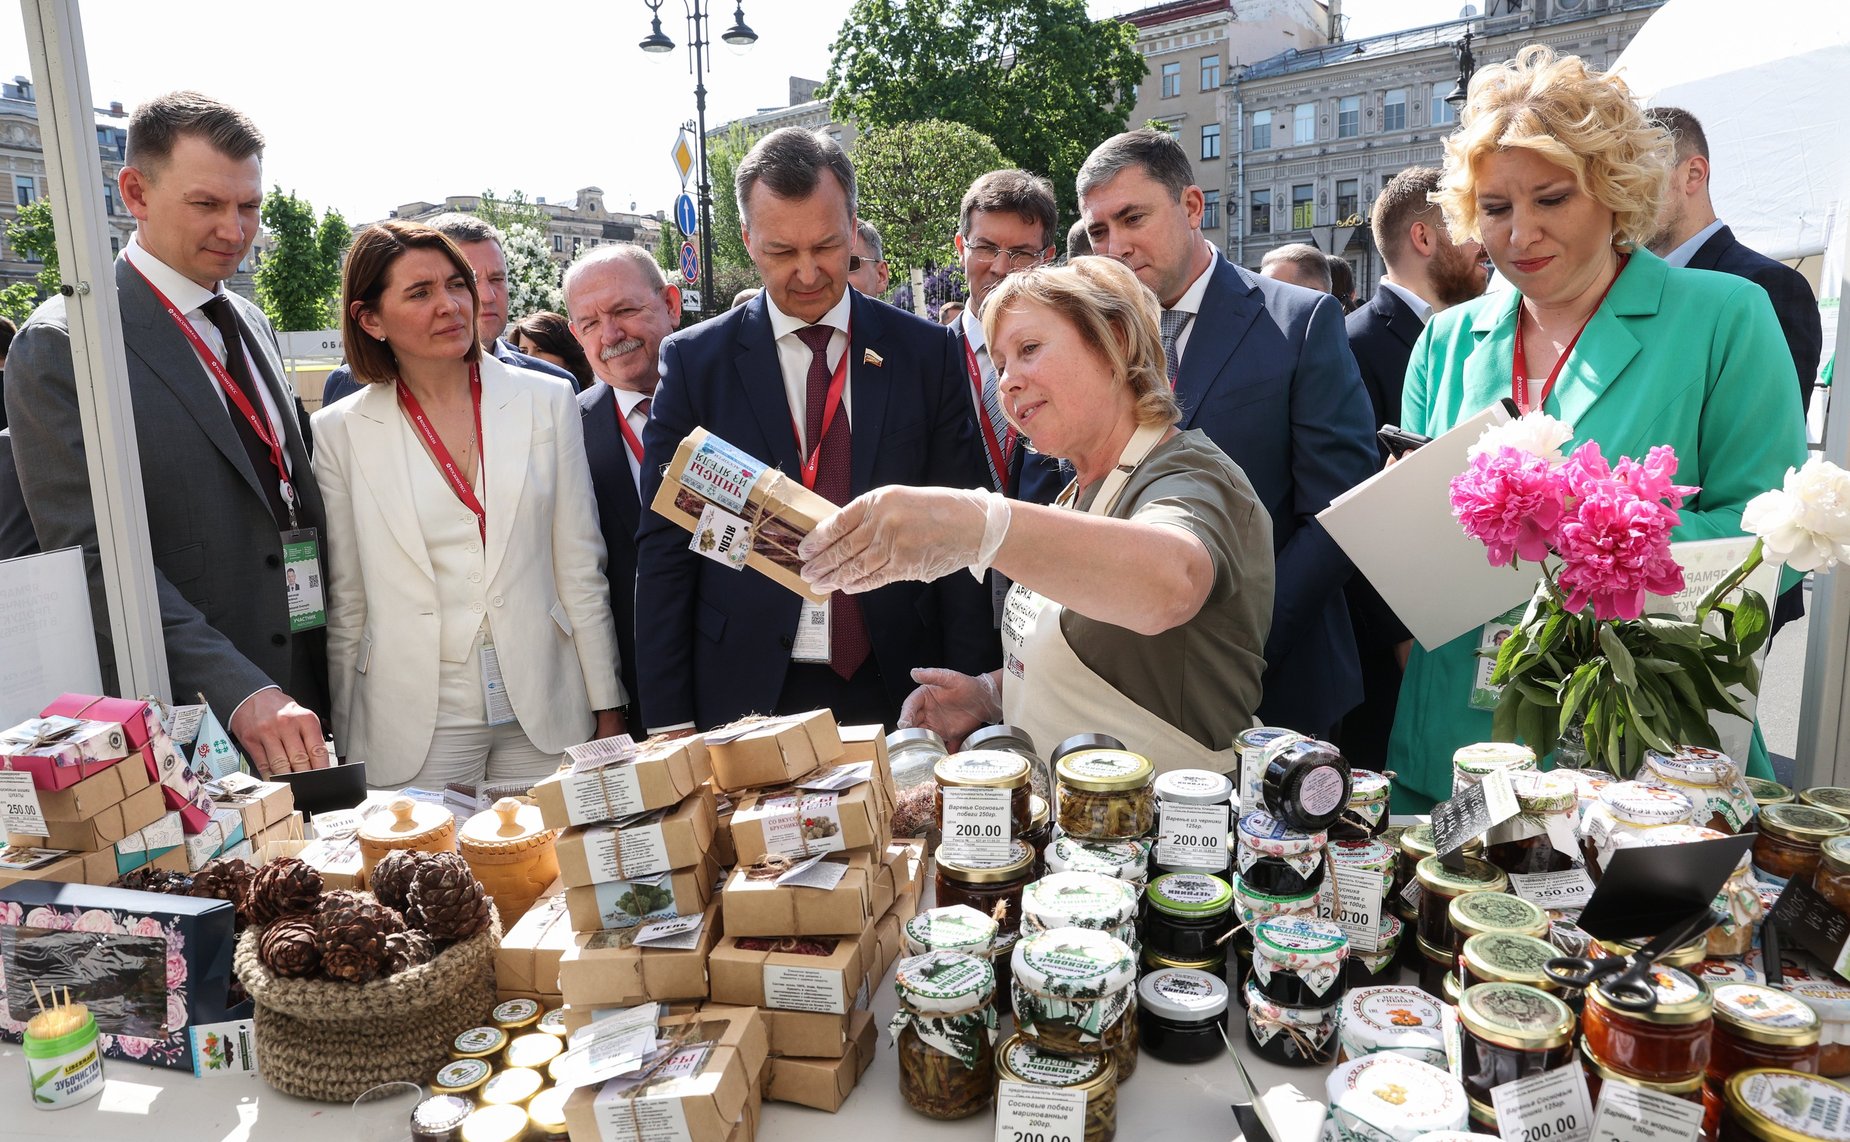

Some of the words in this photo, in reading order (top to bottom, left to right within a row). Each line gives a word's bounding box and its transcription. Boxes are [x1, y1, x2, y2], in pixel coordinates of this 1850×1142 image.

[694, 452, 732, 478] ЯГЕЛЯ
[688, 461, 746, 499] ЧИПСЫ
[732, 473, 748, 487] ИЗ
[718, 524, 736, 553] ЯГЕЛЬ
[7, 804, 36, 815] 250.00
[956, 824, 1001, 837] 200.00
[1174, 834, 1217, 847] 200.00
[1535, 886, 1584, 897] 350.00
[1037, 957, 1097, 970] СОСНОВЫЕ
[935, 965, 980, 990] СОСНОВЫЕ
[1162, 987, 1198, 995] ЧЕРНИКИ
[1022, 1062, 1080, 1075] СОСНОВЫЕ
[1033, 1057, 1072, 1068] ПОБЕГИ
[55, 1060, 99, 1091] ЗУБОЧИСТКИ
[1008, 1100, 1045, 1108] Сосновые
[1047, 1104, 1074, 1112] побеги
[1012, 1110, 1068, 1120] маринованные
[1029, 1120, 1051, 1129] 200гр.
[1521, 1114, 1576, 1142] 200.00
